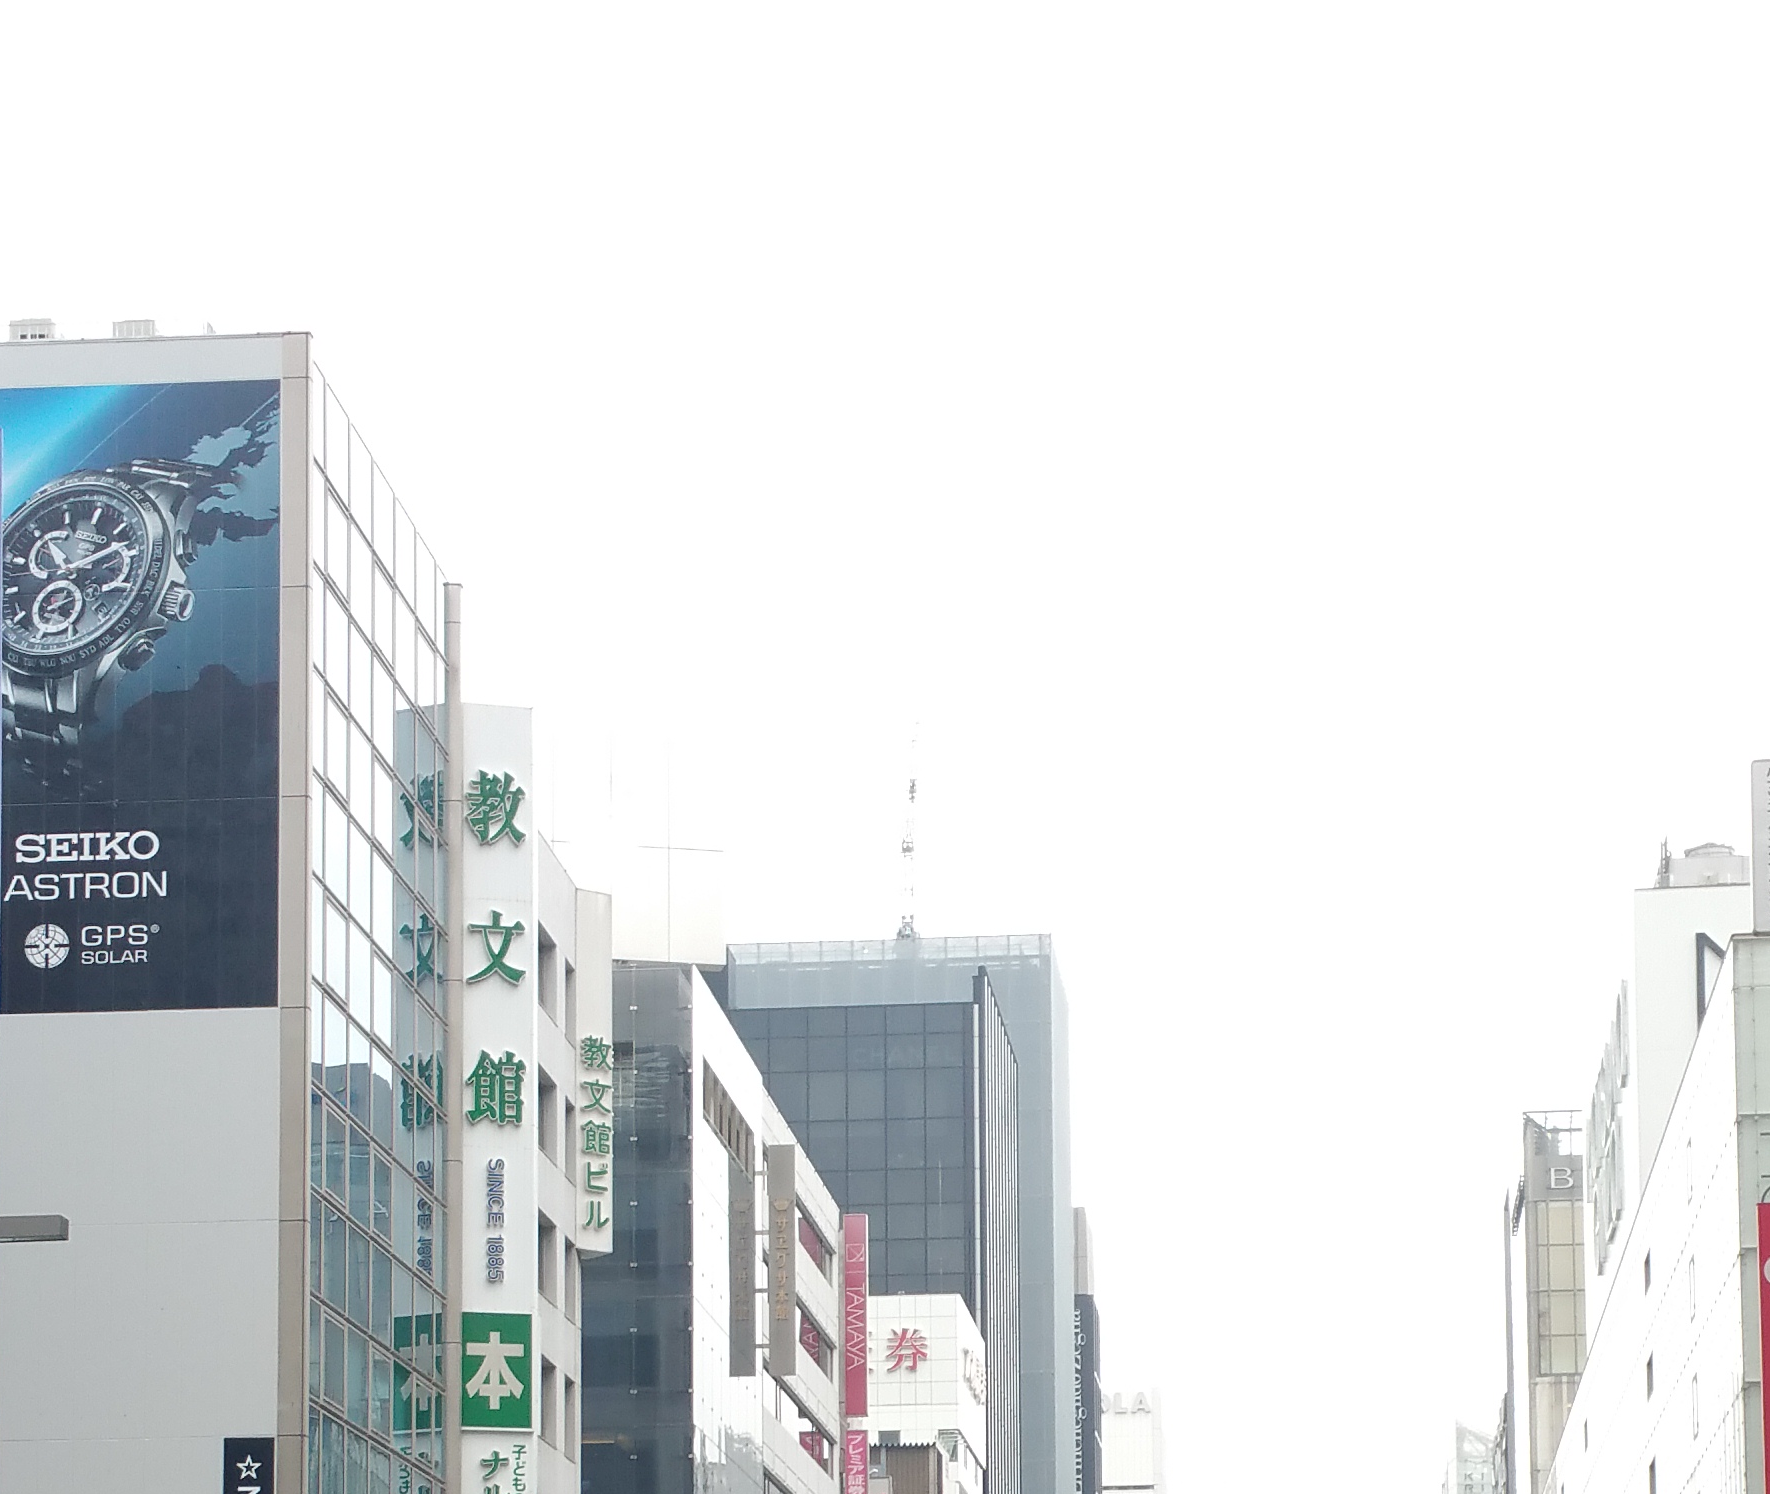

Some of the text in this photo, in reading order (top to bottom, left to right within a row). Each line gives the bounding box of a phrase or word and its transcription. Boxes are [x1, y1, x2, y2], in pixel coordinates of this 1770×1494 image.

[74, 530, 108, 545] SEIKO
[3, 869, 168, 902] ASTRON
[14, 830, 160, 863] SEIKO
[80, 949, 149, 965] SOLAR
[465, 769, 527, 1126] 教文館
[581, 1034, 614, 1231] 教文館ビル
[487, 1157, 506, 1283] SINCE 1885
[845, 1282, 866, 1371] TAMAYA
[465, 1331, 526, 1411] 本
